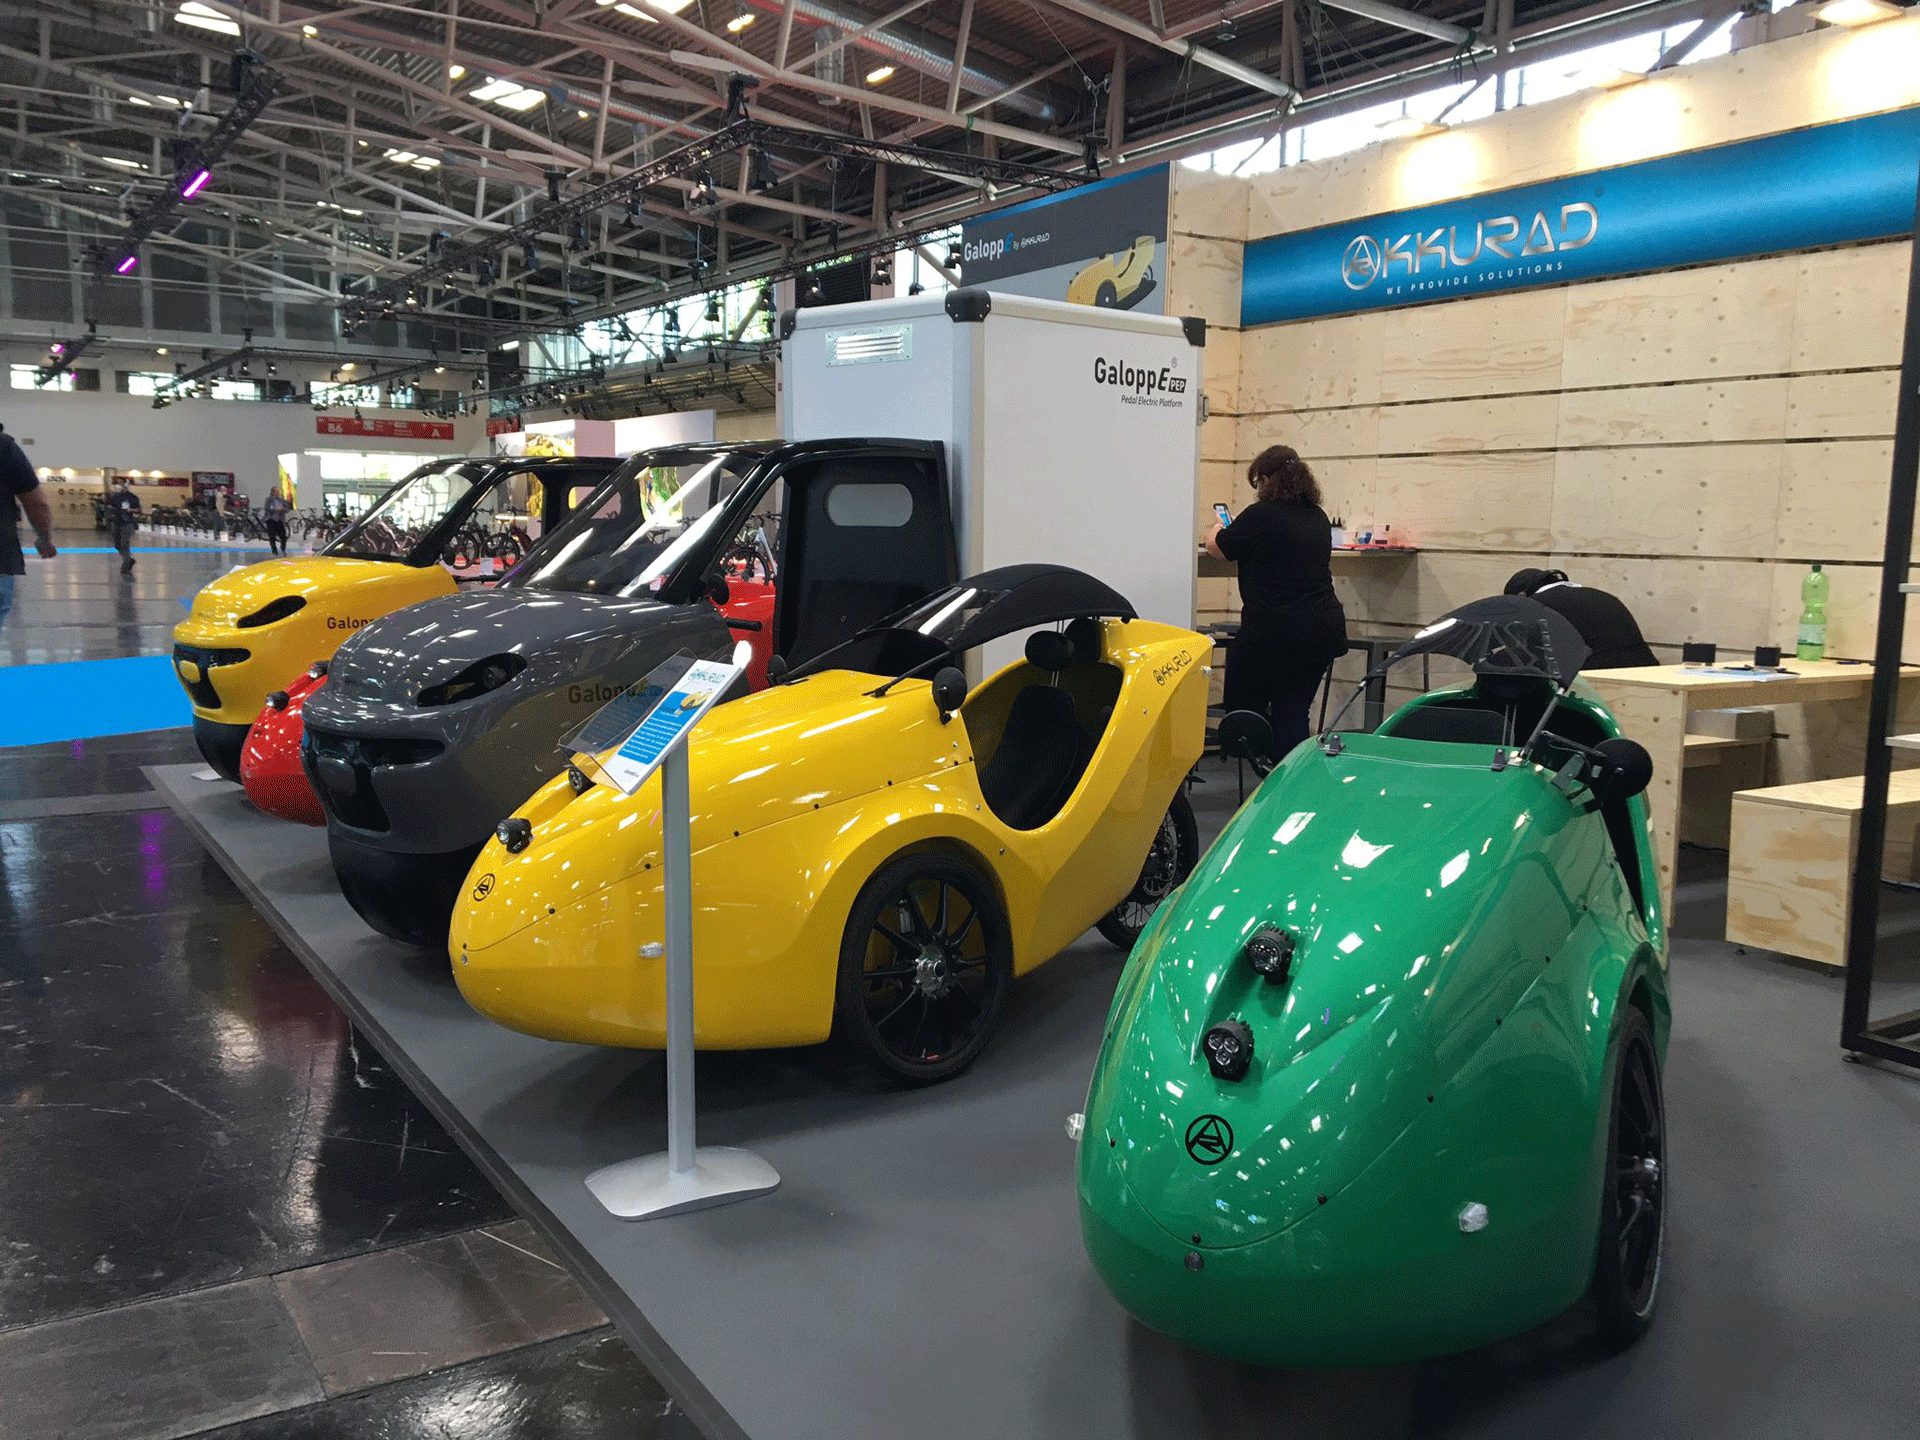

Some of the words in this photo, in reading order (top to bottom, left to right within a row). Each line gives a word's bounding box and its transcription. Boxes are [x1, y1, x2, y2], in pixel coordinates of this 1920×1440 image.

[1342, 202, 1598, 290] AKKURAD
[1387, 286, 1402, 295] WE
[1411, 275, 1469, 292] PROVIDE
[1479, 261, 1563, 281] SOLUTIONS
[1094, 356, 1171, 395] GaloppE
[1169, 378, 1186, 393] PEP
[1121, 394, 1138, 405] Pedal
[1139, 395, 1158, 407] Electric
[1159, 397, 1183, 408] Platform
